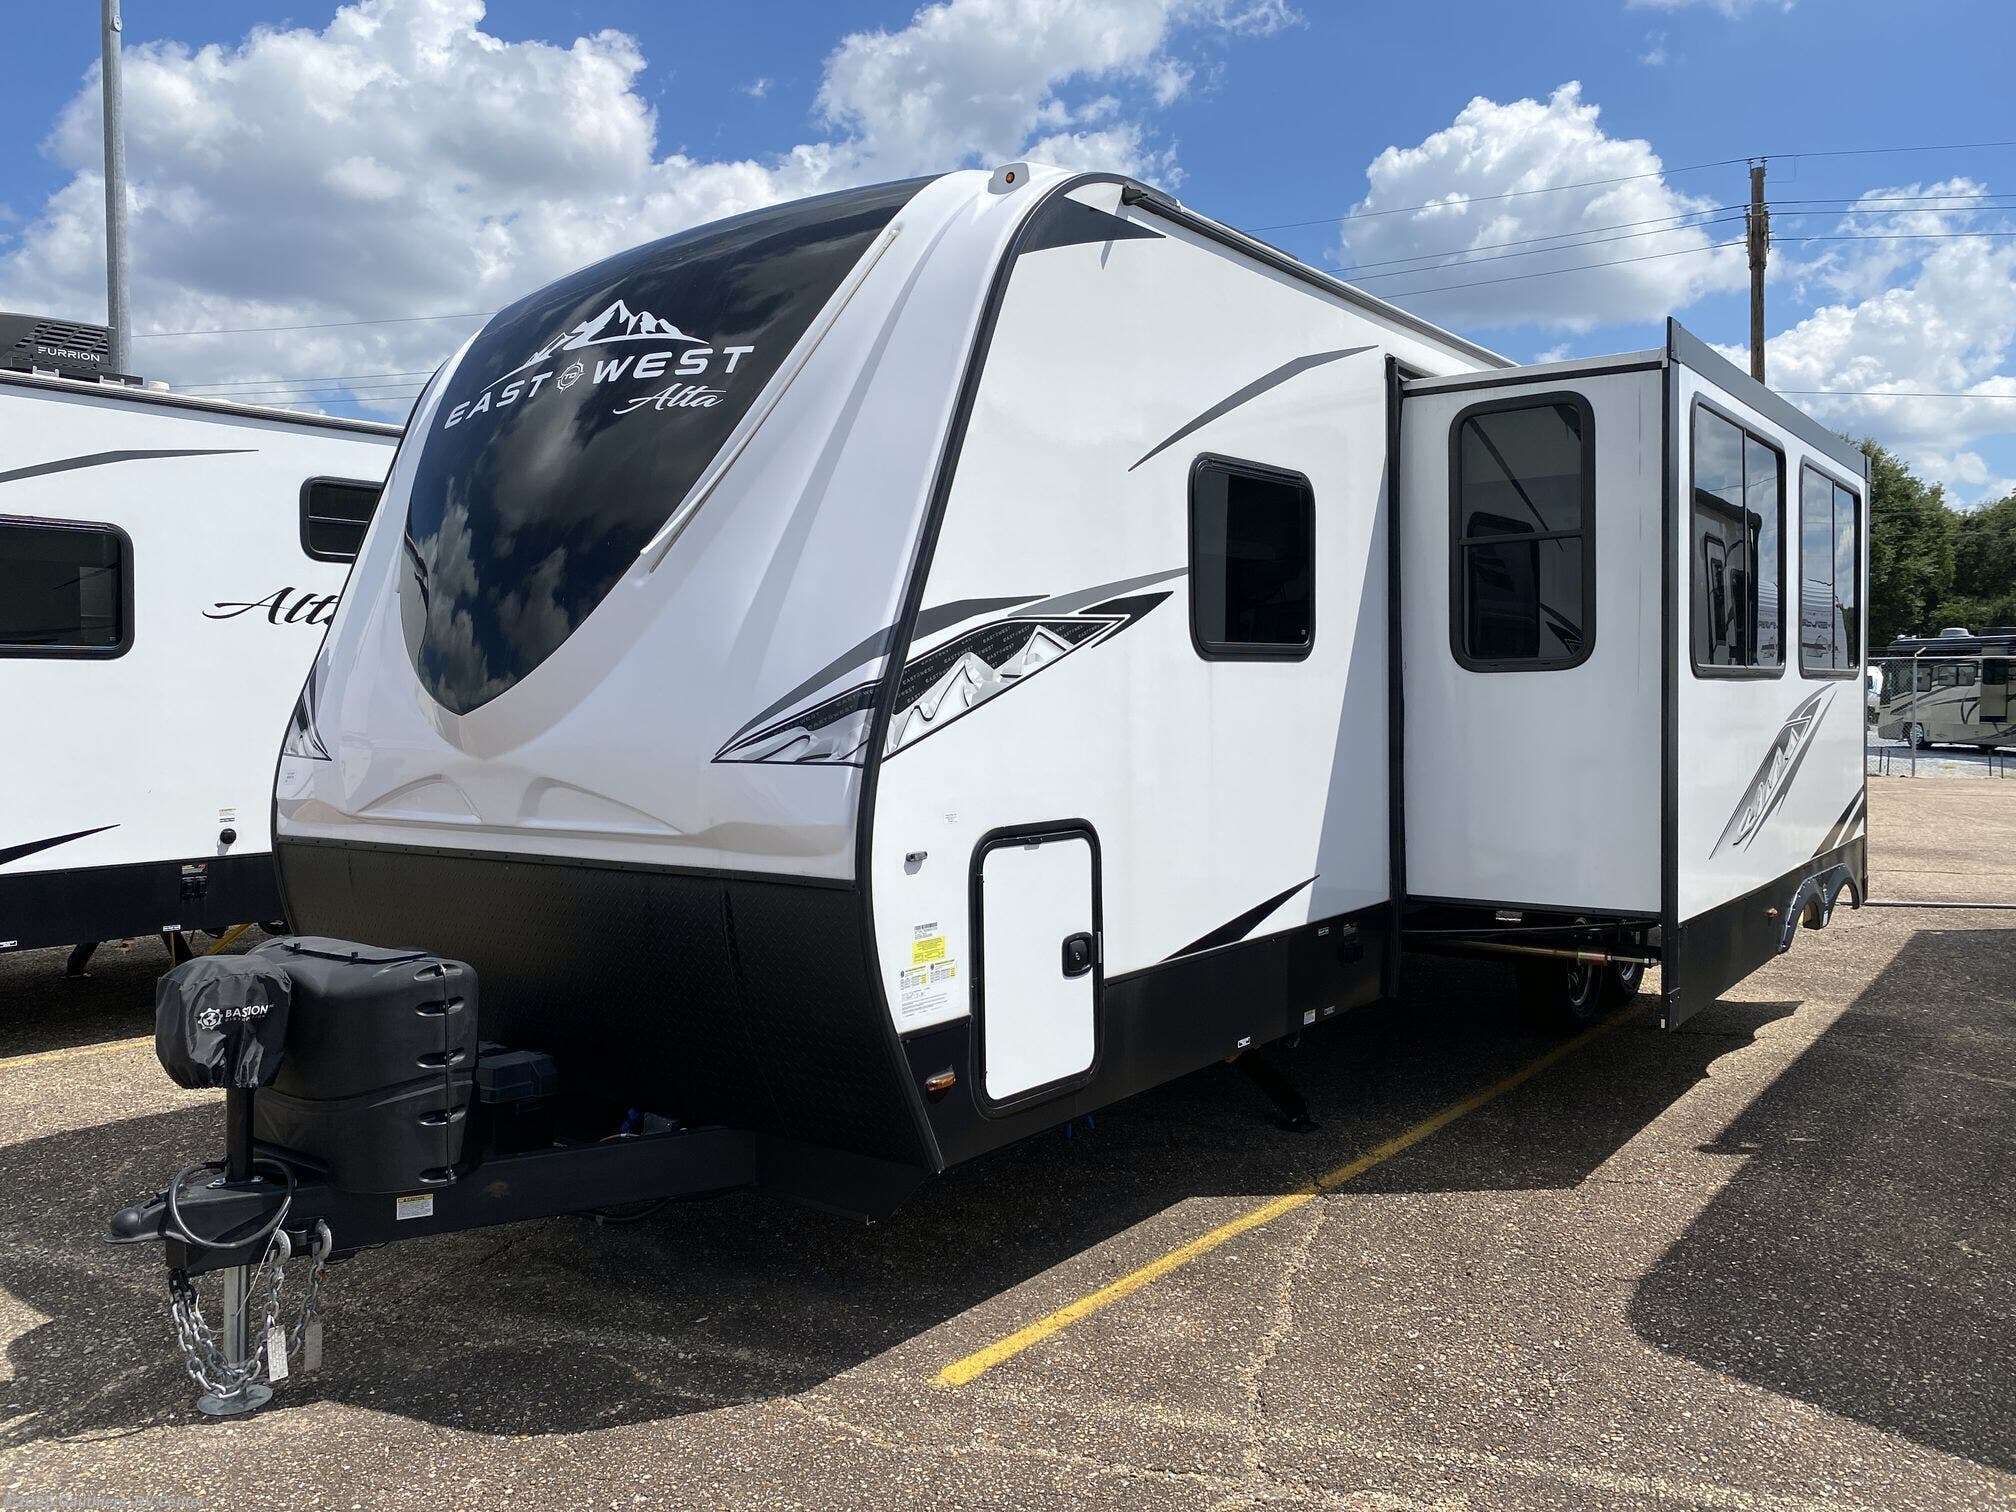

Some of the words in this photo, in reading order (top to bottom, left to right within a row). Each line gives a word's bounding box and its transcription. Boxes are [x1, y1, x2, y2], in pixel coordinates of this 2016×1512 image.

[38, 346, 100, 362] FURRION
[444, 371, 553, 429] EAST
[592, 345, 755, 385] WEST
[613, 383, 727, 415] Alta
